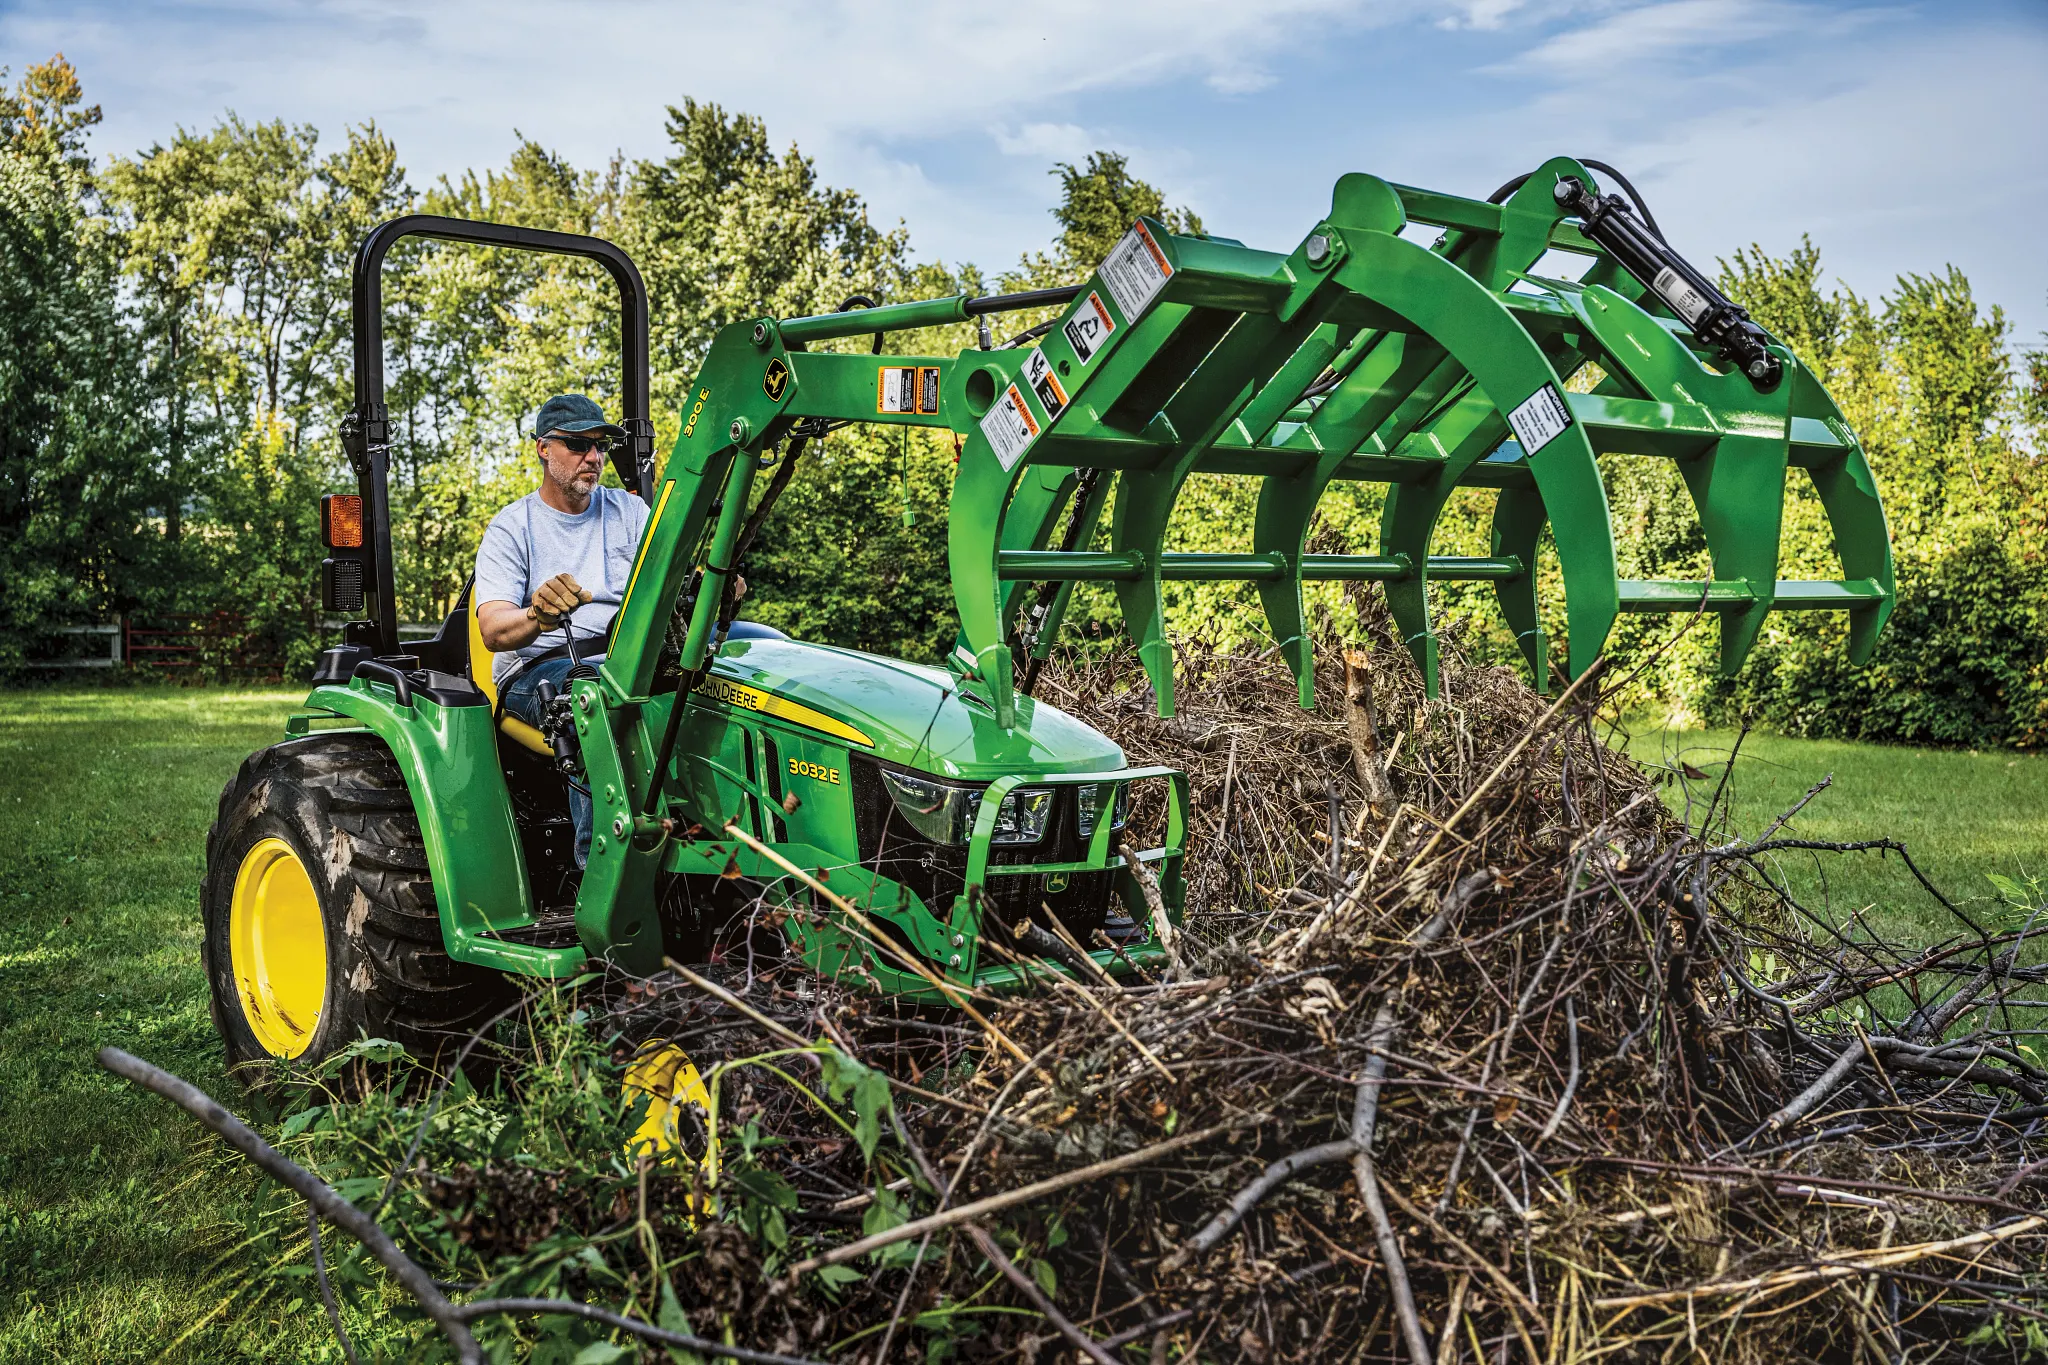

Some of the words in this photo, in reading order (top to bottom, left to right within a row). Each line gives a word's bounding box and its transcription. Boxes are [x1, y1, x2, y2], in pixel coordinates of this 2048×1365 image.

[1143, 234, 1166, 268] WARNING
[684, 386, 711, 439] 300E
[1014, 394, 1037, 432] WARNING
[1546, 384, 1571, 423] IMPORTANT
[693, 680, 720, 699] OHN
[721, 682, 758, 709] DEERE
[788, 757, 841, 786] 3032E
